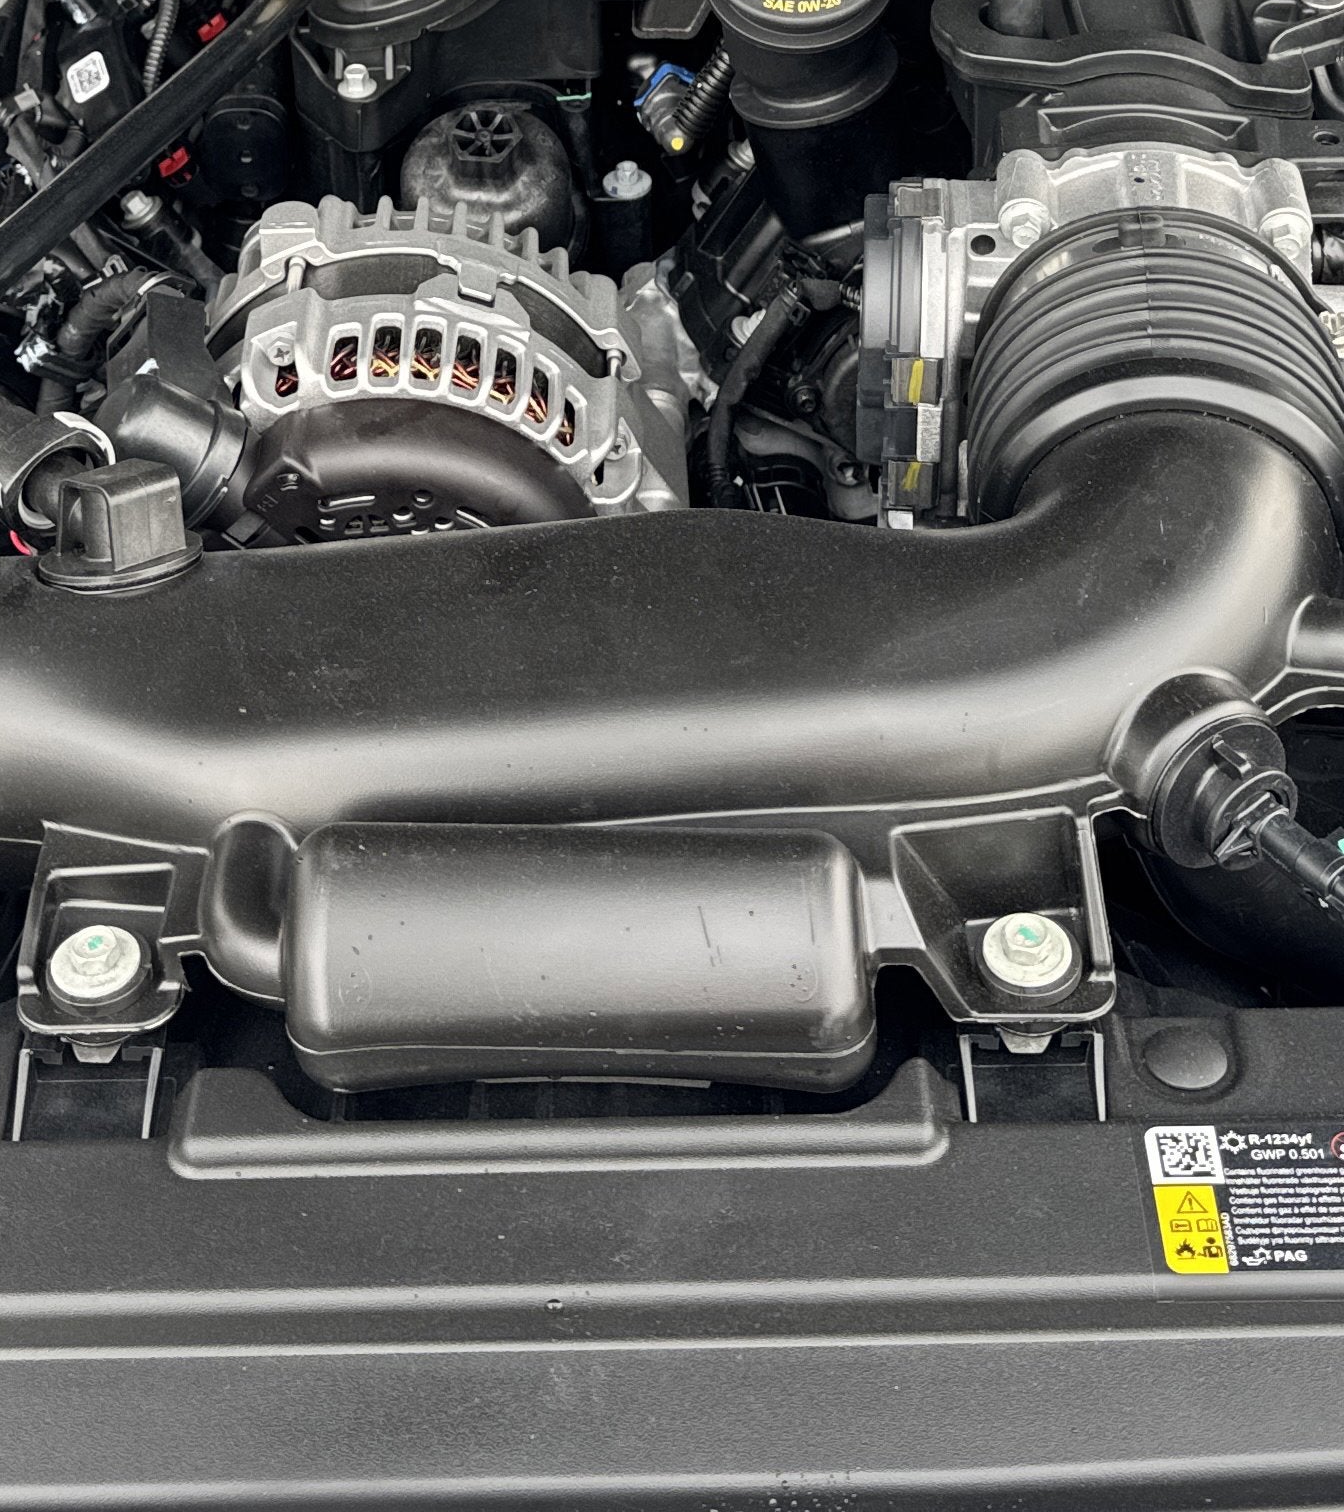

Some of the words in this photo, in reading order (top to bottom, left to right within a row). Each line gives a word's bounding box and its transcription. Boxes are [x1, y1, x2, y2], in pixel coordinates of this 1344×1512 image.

[1248, 1133, 1313, 1147] R-1234yf
[1250, 1149, 1286, 1161] GWP
[1288, 1148, 1325, 1160] 0.501
[1274, 1250, 1308, 1262] PAG
